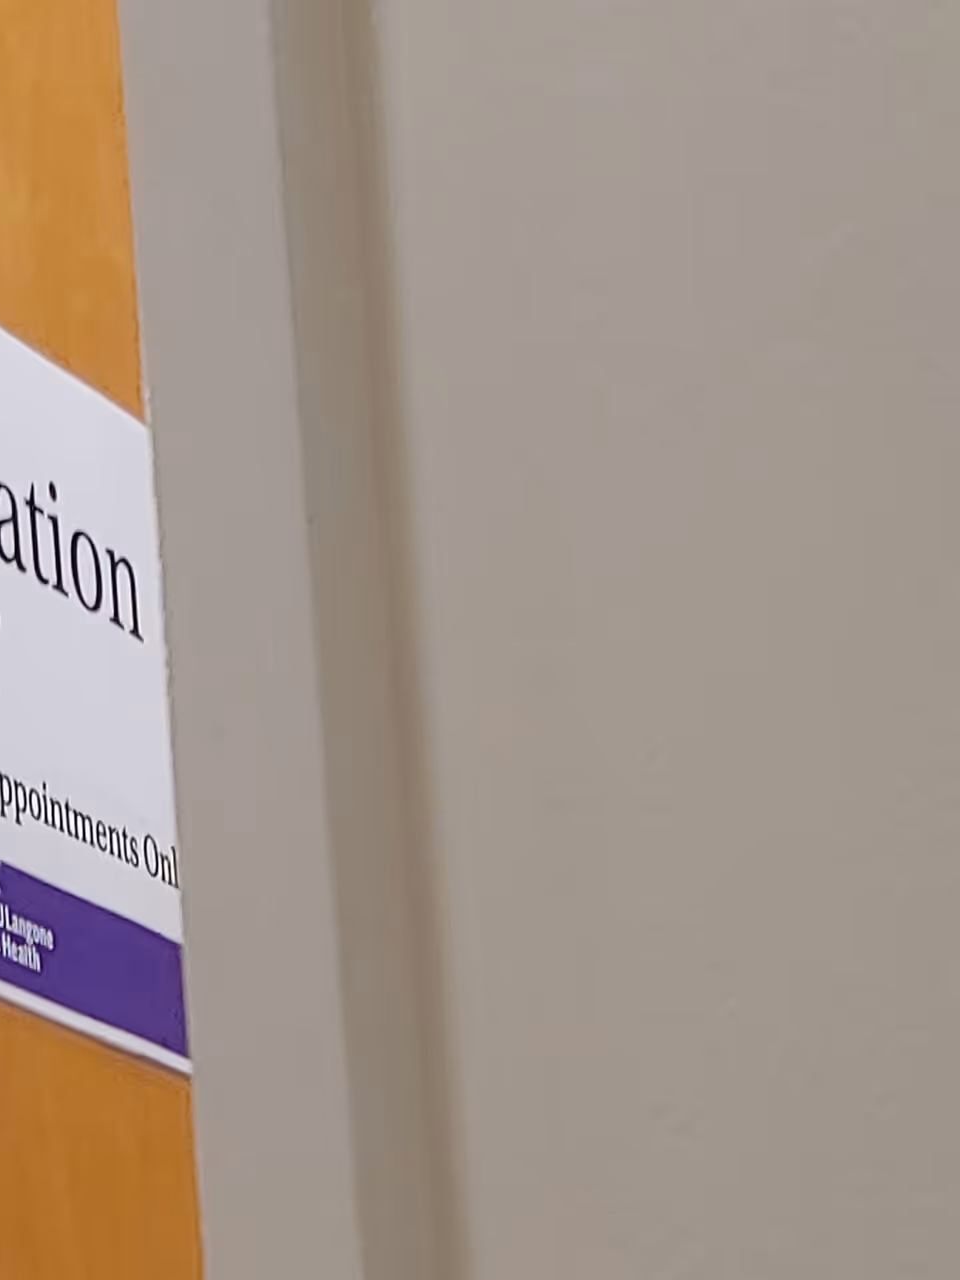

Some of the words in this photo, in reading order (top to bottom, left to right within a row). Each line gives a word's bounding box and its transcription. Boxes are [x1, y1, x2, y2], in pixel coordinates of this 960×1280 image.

[143, 833, 180, 890] Onl
[4, 904, 54, 951] Langone
[1, 931, 41, 973] Health
